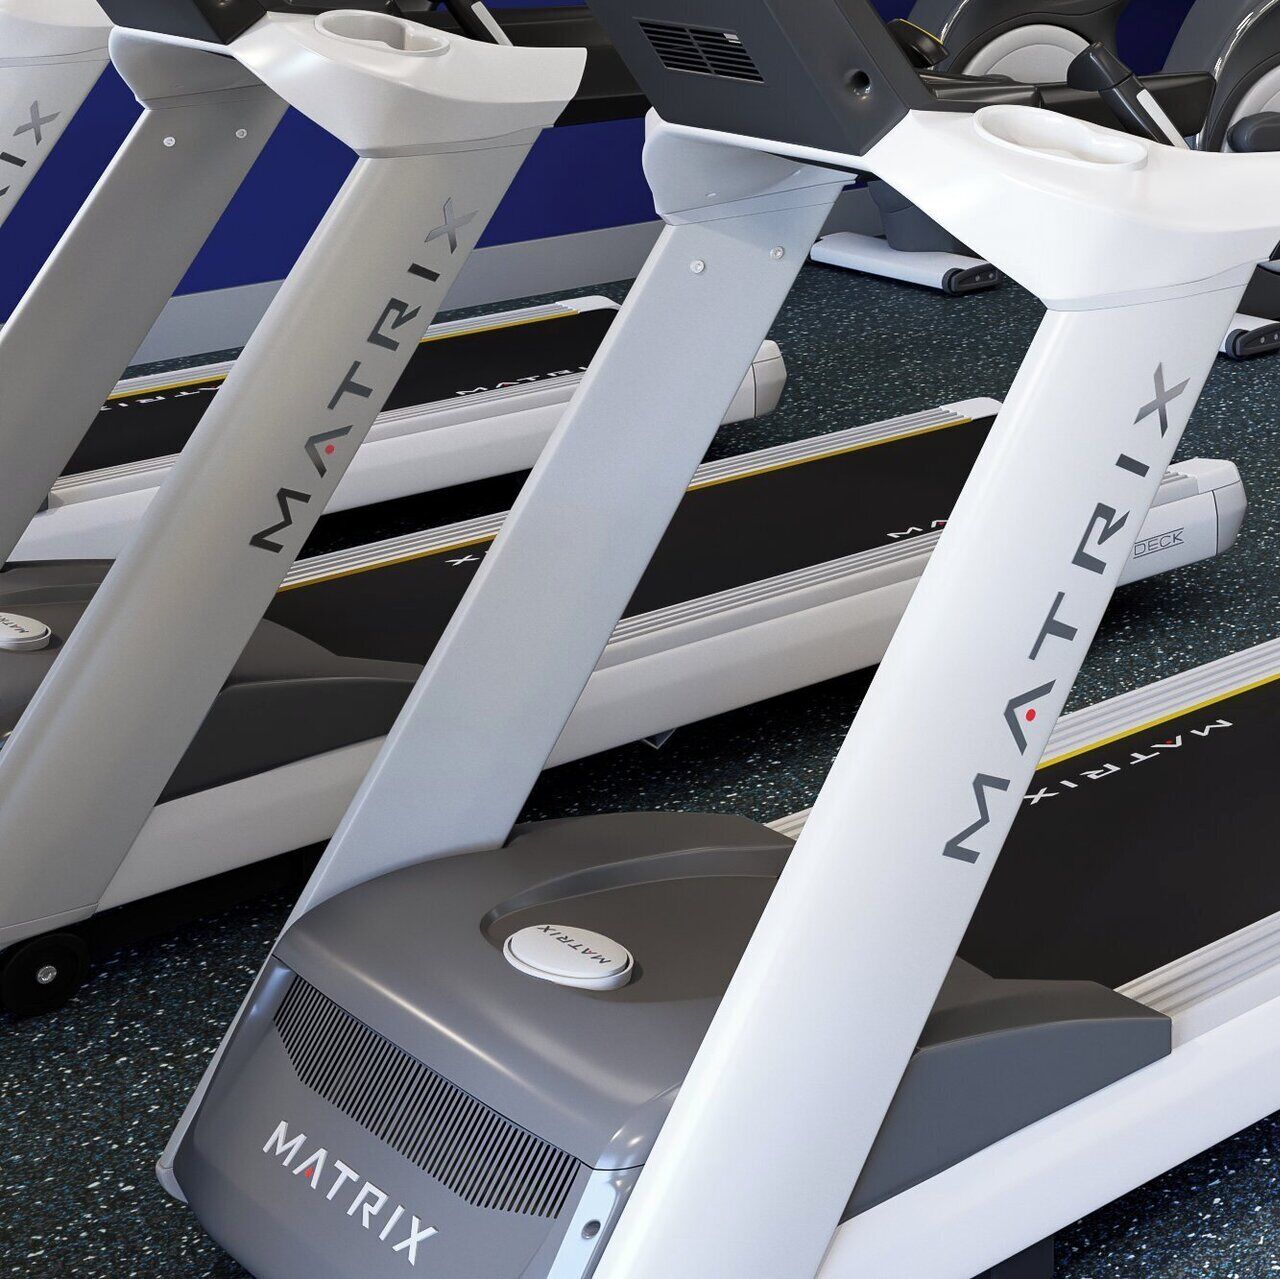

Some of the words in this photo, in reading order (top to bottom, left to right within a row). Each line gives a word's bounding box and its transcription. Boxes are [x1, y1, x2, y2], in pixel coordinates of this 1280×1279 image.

[249, 197, 479, 554] MATRIX
[456, 366, 588, 396] MATRI
[1133, 529, 1185, 558] DECK
[942, 362, 1191, 864] MATRIX
[1023, 719, 1234, 806] MATRIX
[537, 925, 612, 965] MATRIX
[262, 1120, 440, 1267] MATRIX
